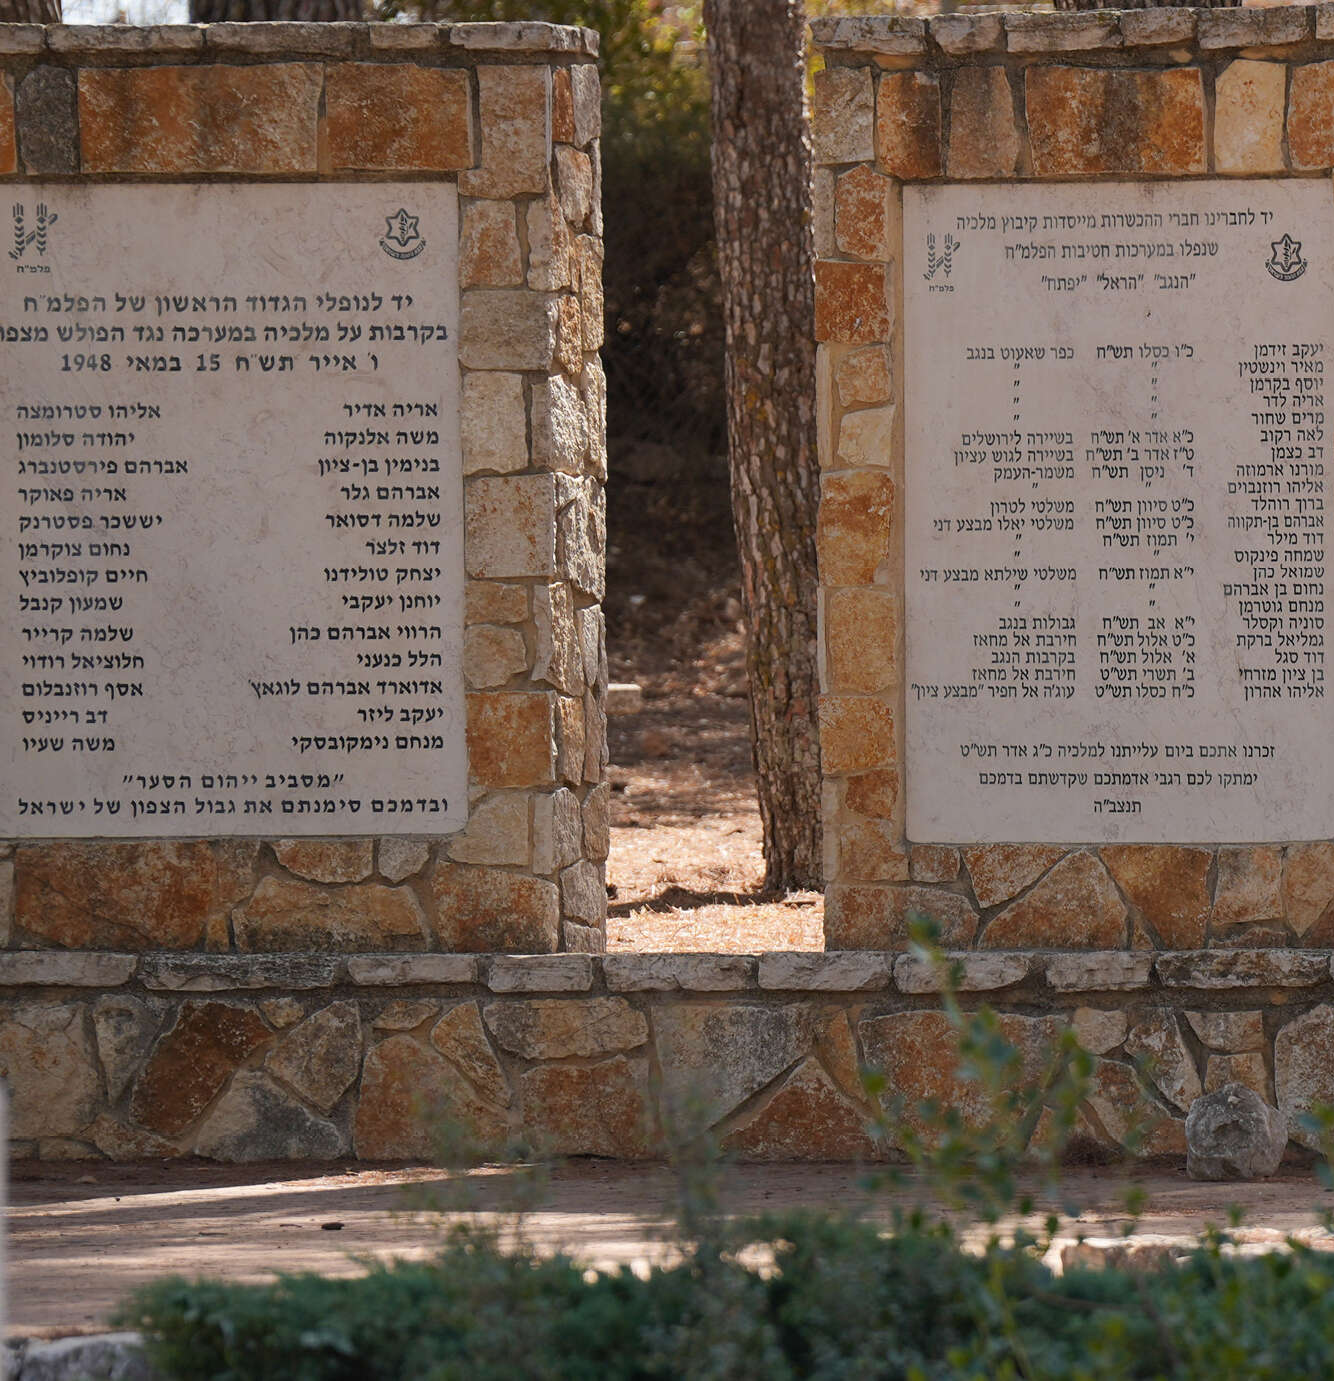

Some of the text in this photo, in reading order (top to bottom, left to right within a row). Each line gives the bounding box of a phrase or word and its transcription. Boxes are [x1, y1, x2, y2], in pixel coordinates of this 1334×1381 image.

[956, 207, 1274, 234] יד לחברינו חברי ההכשרות מייסדות קיבוץ מלכיה
[1061, 244, 1110, 259] חטיבות
[1115, 243, 1175, 259] במערכות
[1179, 238, 1219, 257] שנפלו
[115, 292, 146, 312] של
[154, 295, 237, 317] הראשון
[245, 295, 307, 312] הגדוד
[316, 291, 383, 312] לנופלי
[390, 294, 413, 312] יד
[56, 322, 125, 342] הפולש
[132, 325, 164, 342] נגד
[171, 325, 257, 343] במערכה
[263, 321, 330, 342] מלכיה
[336, 321, 362, 343] על
[368, 324, 448, 346] בקרבות
[966, 347, 995, 360] בנגב
[1050, 346, 1075, 360] כפר
[1138, 342, 1170, 359] כסלו
[1292, 343, 1324, 360] יעקב
[61, 353, 112, 372] 1948
[126, 355, 182, 372] במאי
[196, 353, 221, 372] 15
[308, 354, 357, 372] אייר
[1262, 391, 1324, 409] אריה לדר
[108, 402, 161, 419] אליהו
[342, 402, 438, 418] אריה אדיר
[961, 429, 1074, 446] בשיירה לירושלים
[1144, 431, 1168, 444] אדר
[1260, 424, 1324, 446] לאה רקוב
[953, 446, 1074, 467] בשיירה לגוש עציון
[1144, 448, 1170, 461] אדר
[1270, 446, 1324, 463] דב כצמן
[124, 459, 188, 474] אברהם
[317, 457, 441, 477] בנימין בן-ציון
[80, 487, 127, 502] אריה
[340, 483, 440, 501] אברהם גלר
[933, 518, 951, 532] דני
[956, 518, 993, 533] מבצע
[1030, 514, 1074, 531] משלטי
[1136, 516, 1166, 533] סיוון
[1227, 514, 1324, 532] אברהם בן-תקווה
[18, 542, 130, 561] נחום צוקרמן
[365, 538, 441, 556] דוד זלצר
[919, 569, 938, 582] דני
[943, 568, 979, 583] מבצע
[1033, 565, 1077, 581] משלטי
[1139, 567, 1170, 580] תמוז
[1252, 563, 1325, 583] שמואל כהן
[68, 596, 123, 615] שמעון
[341, 594, 441, 614] יוחנן יעקבי
[79, 624, 134, 642] שלמה
[289, 625, 442, 645] הרווי אברהם כהן
[21, 679, 144, 701] אסף רוזנבלום
[306, 681, 371, 696] אברהם
[376, 680, 443, 695] אדוארד
[987, 685, 1017, 698] חפיר
[1021, 681, 1039, 698] אל
[1135, 681, 1167, 698] כסלו
[1244, 682, 1324, 702] אליהו אהרון
[71, 737, 115, 752] משה
[291, 735, 444, 755] מנחם נימקובסקי
[1002, 744, 1028, 757] אדר
[1058, 741, 1105, 758] למלכיה
[1110, 741, 1159, 759] עלייתנו
[1164, 745, 1194, 758] ביום
[1199, 745, 1237, 758] אתכם
[1242, 744, 1275, 758] זכרנו
[200, 774, 258, 789] ייהום
[978, 769, 1258, 789] ימתקו לכם רגבי אדמתכם שקדשתם בדמכם
[18, 797, 448, 819] ובדמכם סימנתם את גבול הצפון של ישראל
